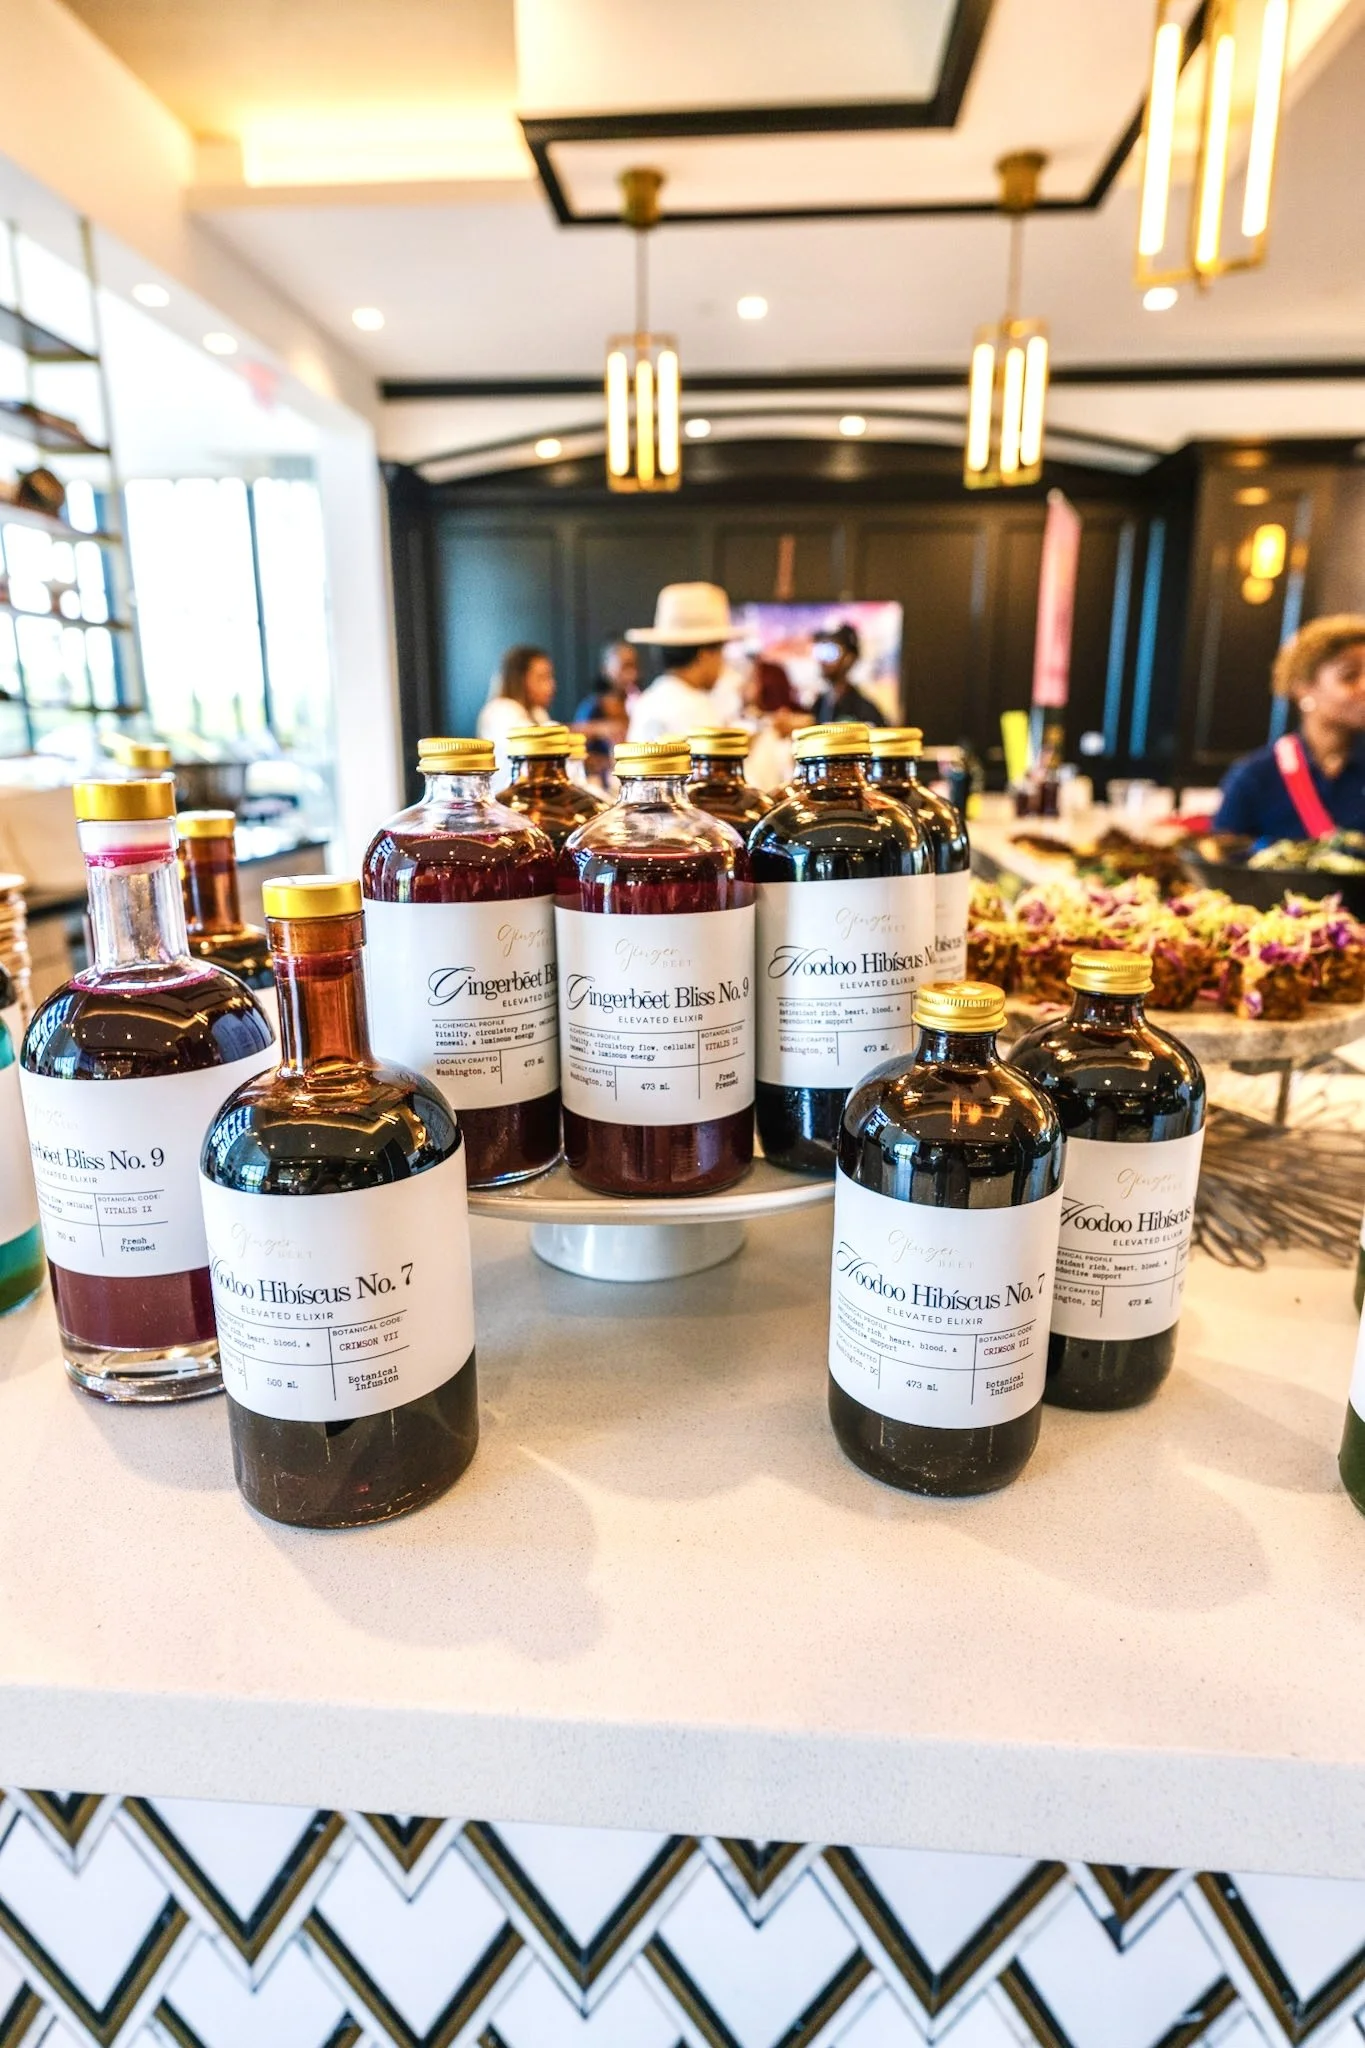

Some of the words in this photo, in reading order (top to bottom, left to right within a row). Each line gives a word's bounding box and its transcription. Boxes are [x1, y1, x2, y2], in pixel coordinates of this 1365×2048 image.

[615, 937, 682, 972] Ginger
[840, 979, 888, 989] ELEVATED
[891, 975, 916, 986] ELIXIR
[675, 986, 716, 1009] Bliss
[718, 980, 742, 1005] No.
[743, 976, 750, 999] 9
[502, 994, 542, 1008] ELEVATED
[479, 1019, 505, 1028] PROFILE
[618, 1015, 669, 1024] ELEVATED
[673, 1013, 704, 1024] ELIXIR
[825, 1017, 853, 1026] support
[476, 1025, 519, 1037] circulatory
[480, 1035, 512, 1046] luminous
[515, 1031, 534, 1041] energy
[594, 1041, 635, 1052] circulatory
[663, 1041, 696, 1051] cellular
[705, 1039, 730, 1051] VITALIS
[827, 1046, 837, 1054] DC
[863, 1044, 878, 1053] 473
[467, 1056, 498, 1064] CRAFTED
[631, 1053, 656, 1061] energy
[523, 1058, 535, 1068] 473
[436, 1067, 486, 1078] Washington,
[490, 1065, 501, 1074] DC
[606, 1080, 616, 1089] DC
[640, 1081, 656, 1091] 473
[64, 1147, 105, 1171] Bliss
[108, 1150, 146, 1171] No.
[150, 1147, 165, 1168] 9
[70, 1174, 98, 1184] ELIXIR
[104, 1206, 138, 1215] VITALIS
[142, 1205, 152, 1213] IX
[122, 1237, 147, 1246] Fresh
[888, 1229, 960, 1263] Ginger
[1113, 1236, 1160, 1247] ELEVATED
[120, 1243, 156, 1253] Pressed
[1085, 1255, 1112, 1263] PROFILE
[355, 1272, 397, 1299] No.
[401, 1262, 413, 1286] 7
[1092, 1273, 1122, 1281] support
[1004, 1281, 1034, 1307] No.
[1037, 1272, 1046, 1295] 7
[1068, 1287, 1101, 1296] CRAFTED
[1091, 1299, 1101, 1308] DC
[1128, 1299, 1141, 1308] 473
[240, 1304, 291, 1321] ELEVATED
[296, 1312, 334, 1320] ELIXIR
[887, 1306, 943, 1324] ELEVATED
[947, 1317, 983, 1325] ELIXIR
[332, 1324, 377, 1337] BOTANICAL
[380, 1316, 404, 1328] CODE:
[274, 1338, 301, 1348] blood,
[339, 1337, 379, 1352] CRIMSON
[383, 1331, 399, 1342] VII
[979, 1331, 1015, 1344] BOTANICAL
[889, 1335, 915, 1348] heart,
[920, 1343, 947, 1353] blood,
[984, 1343, 1015, 1356] CRIMSON
[1018, 1336, 1029, 1349] VII
[348, 1366, 399, 1384] Botanical
[869, 1366, 878, 1376] DC
[266, 1377, 282, 1388] 500
[355, 1374, 400, 1391] Infusion
[906, 1379, 922, 1389] 473
[985, 1372, 1024, 1389] Botanical
[990, 1380, 1024, 1396] Infusion
